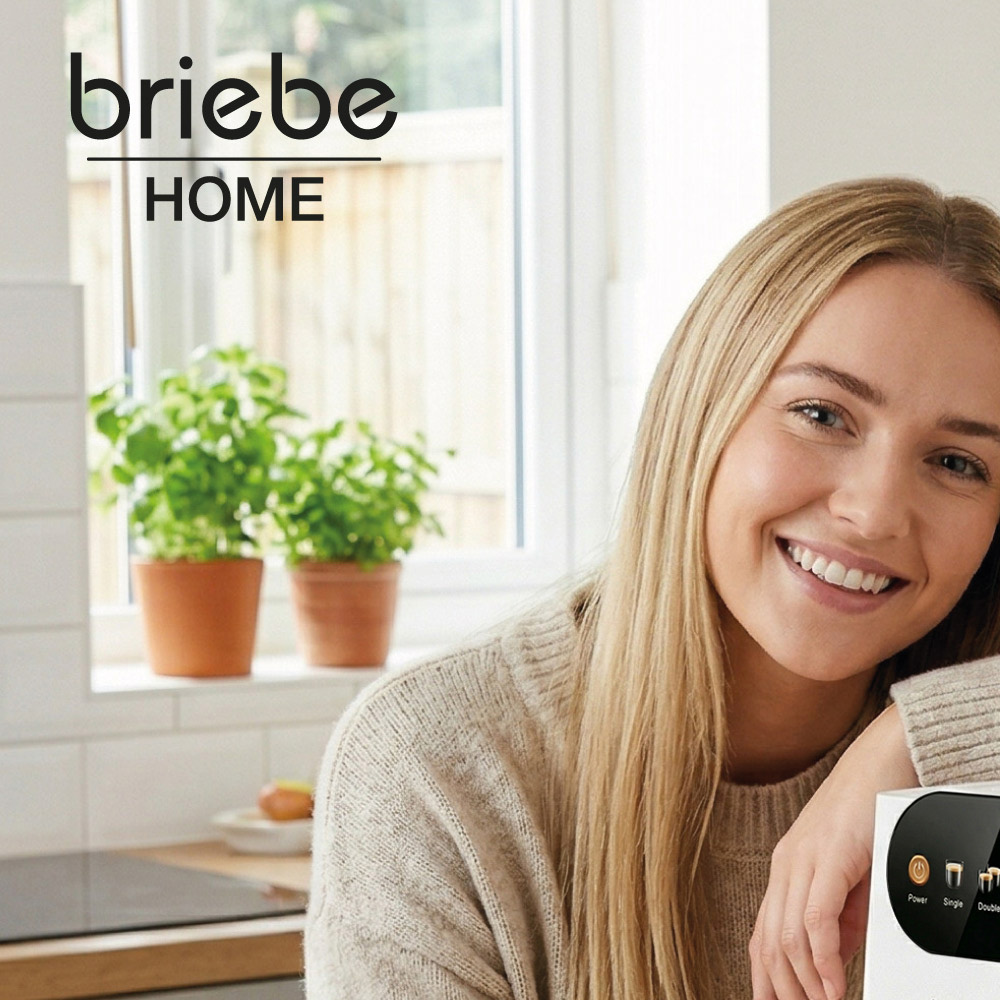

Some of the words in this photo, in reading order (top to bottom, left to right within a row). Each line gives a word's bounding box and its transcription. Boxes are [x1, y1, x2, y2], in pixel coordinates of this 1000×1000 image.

[907, 893, 928, 904] Power
[943, 897, 964, 909] Single
[977, 901, 1000, 913] Double
